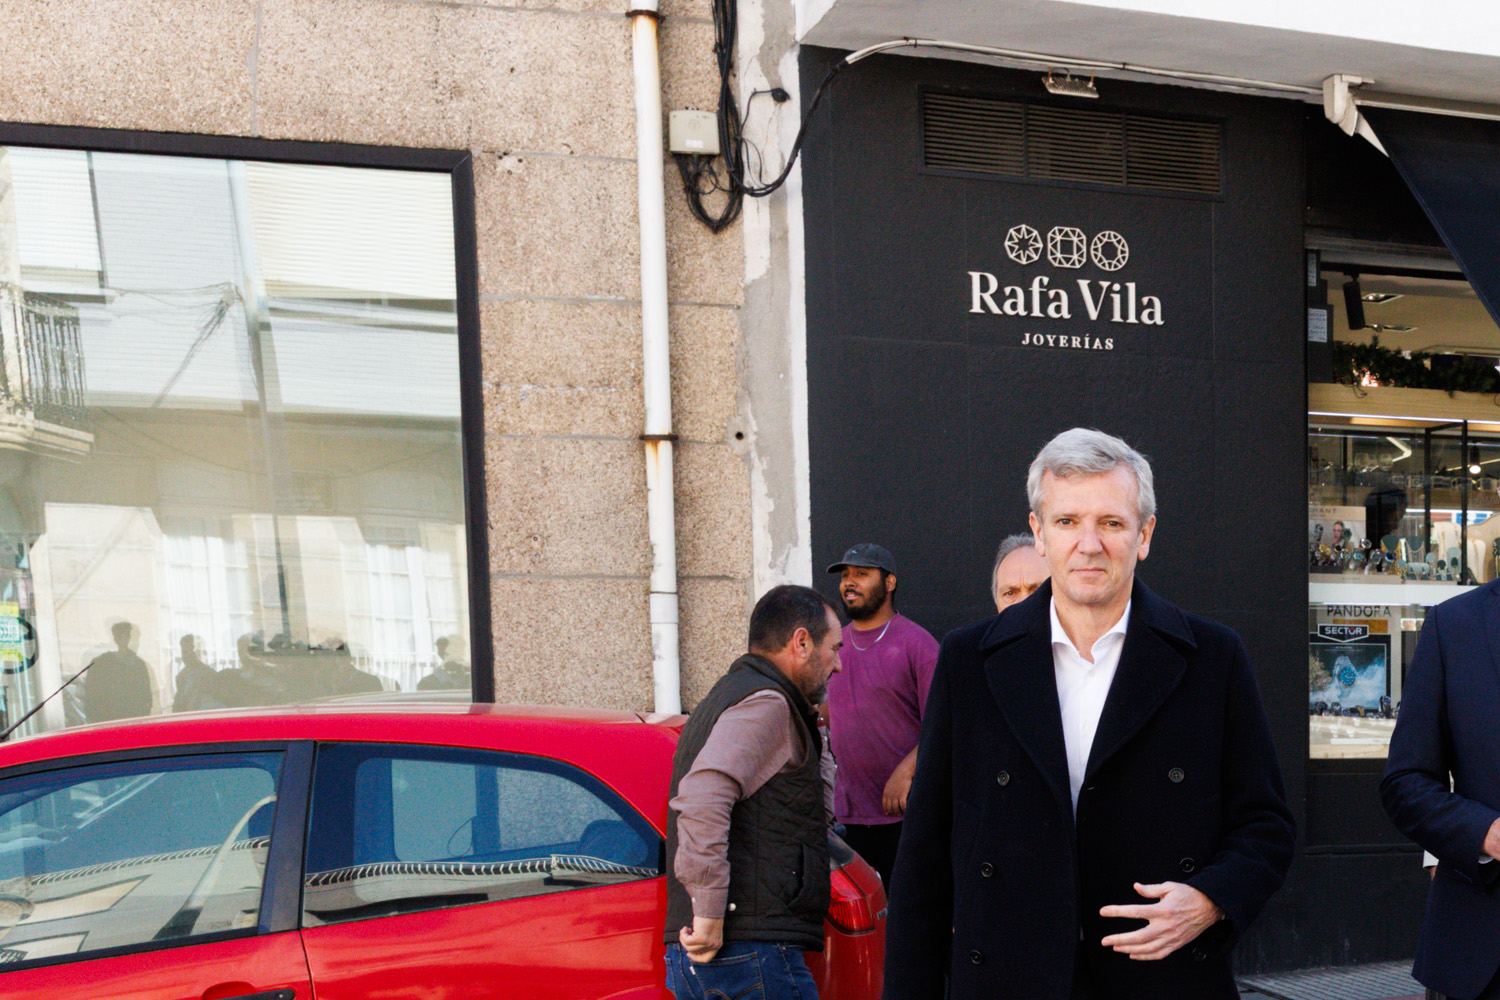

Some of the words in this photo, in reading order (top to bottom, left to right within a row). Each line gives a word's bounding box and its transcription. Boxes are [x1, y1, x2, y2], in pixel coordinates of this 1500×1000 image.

[968, 271, 1072, 319] Rafa
[1077, 279, 1165, 326] Vila
[1022, 332, 1114, 350] JOYERÍAS
[1327, 605, 1391, 617] PANDORA
[1325, 626, 1362, 635] SECTOR
